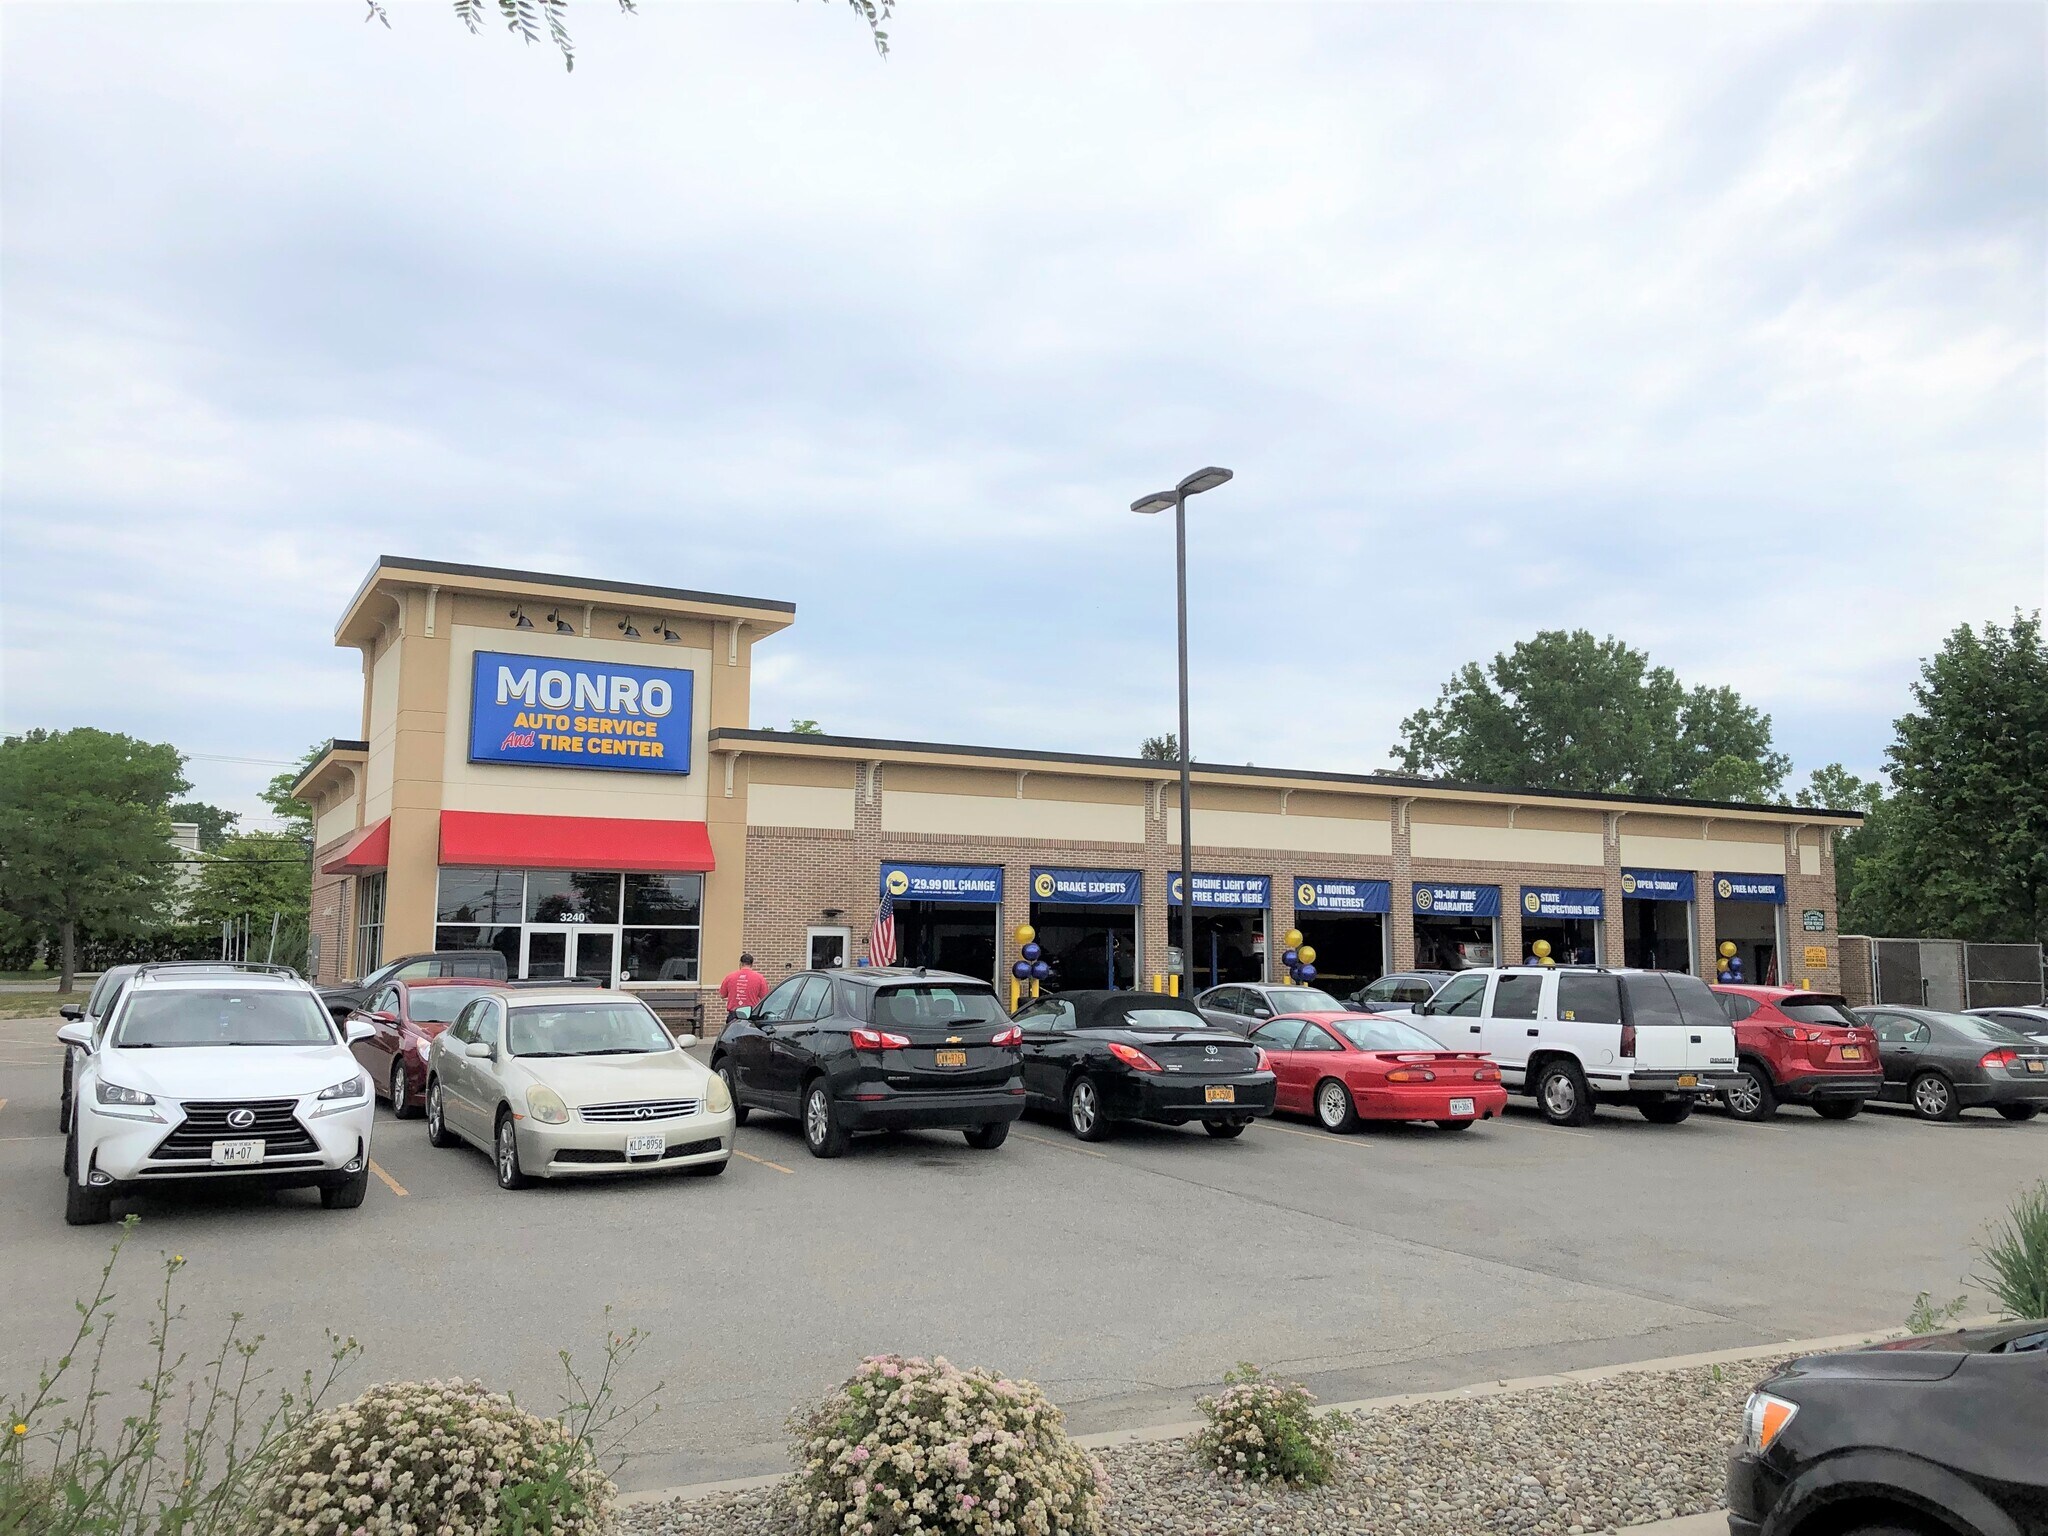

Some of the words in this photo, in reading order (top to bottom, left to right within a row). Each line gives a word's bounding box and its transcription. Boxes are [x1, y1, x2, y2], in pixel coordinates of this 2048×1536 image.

[496, 666, 672, 717] MONRO
[514, 712, 569, 731] AUTO
[574, 715, 657, 737] SERVICE
[501, 731, 535, 750] And
[538, 734, 584, 752] TIRE
[587, 738, 664, 758] CENTER
[911, 878, 942, 890] $29.99
[943, 880, 957, 891] OIL
[958, 880, 996, 891] CHANGE
[1057, 881, 1087, 892] BRAKE
[1088, 882, 1126, 893] EXPERTS
[1192, 878, 1221, 889] ENGINE
[1222, 880, 1245, 890] LIGHT
[1246, 881, 1262, 891] ON?
[1316, 885, 1322, 894] 6
[1324, 885, 1356, 895] MONTHS
[1637, 879, 1654, 889] OPEN
[1655, 881, 1678, 890] SUNDAY
[1732, 885, 1747, 893] FREE
[1757, 885, 1776, 894] CHECK
[1192, 891, 1212, 901] FREE
[1214, 892, 1240, 902] CHECK
[1241, 893, 1263, 903] HERE
[1433, 889, 1459, 899] 30-DAY
[1460, 890, 1476, 900] RIDE
[1540, 892, 1560, 902] STATE
[1317, 897, 1328, 906] NO
[1329, 897, 1365, 907] INTEREST
[1433, 901, 1474, 911] GUARANTEE
[1541, 904, 1582, 914] INSPECTIONS
[1583, 905, 1600, 914] HERE
[560, 912, 585, 922] 3240
